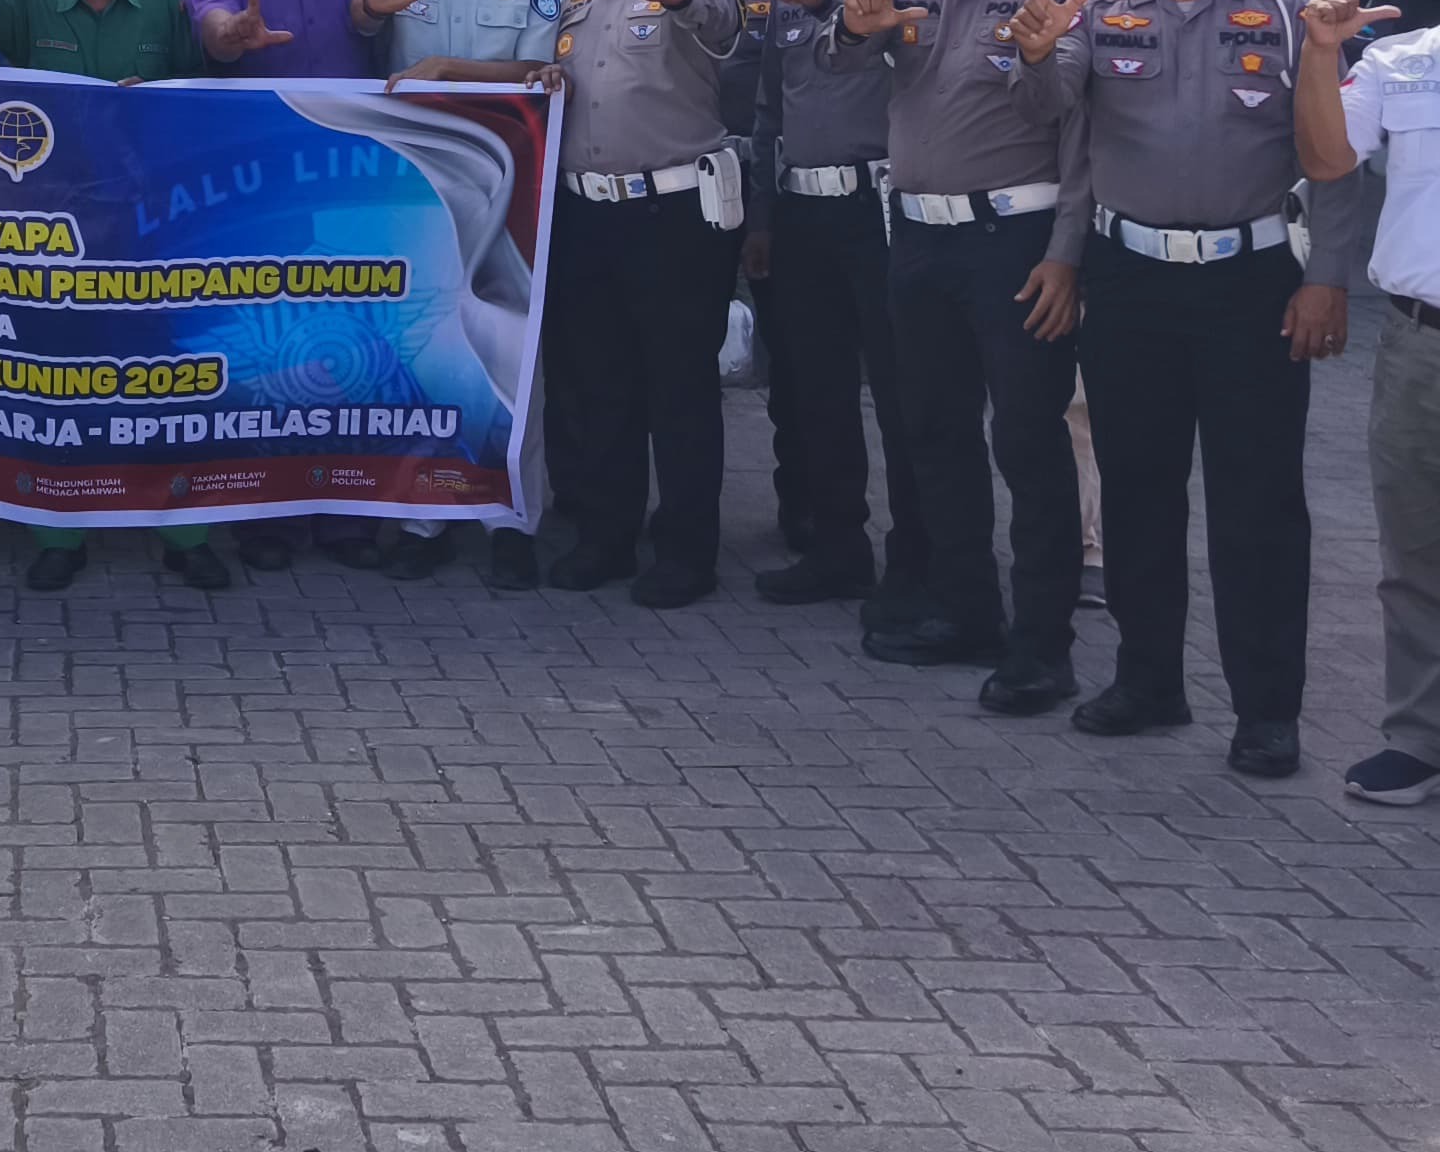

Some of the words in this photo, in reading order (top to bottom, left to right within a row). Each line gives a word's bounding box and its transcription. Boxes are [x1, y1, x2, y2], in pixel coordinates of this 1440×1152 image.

[1219, 31, 1281, 47] POLRI
[50, 265, 281, 300] PENUMPANG
[286, 265, 402, 294] UMUM
[124, 362, 219, 395] 2025
[110, 412, 208, 445] BPTD
[214, 408, 332, 440] KELAS
[338, 408, 360, 435] II
[367, 408, 458, 438] RIAU
[192, 474, 227, 483] TAKKAN
[229, 471, 266, 481] MELAYU
[331, 468, 364, 478] GREEN
[36, 477, 93, 488] MELINDUNGI
[95, 477, 121, 486] TUAH
[191, 481, 225, 492] HILANG
[227, 480, 261, 490] DIBUMI
[331, 477, 376, 487] POLICING
[36, 486, 80, 497] MENJAGA
[81, 487, 126, 496] MARWAH
